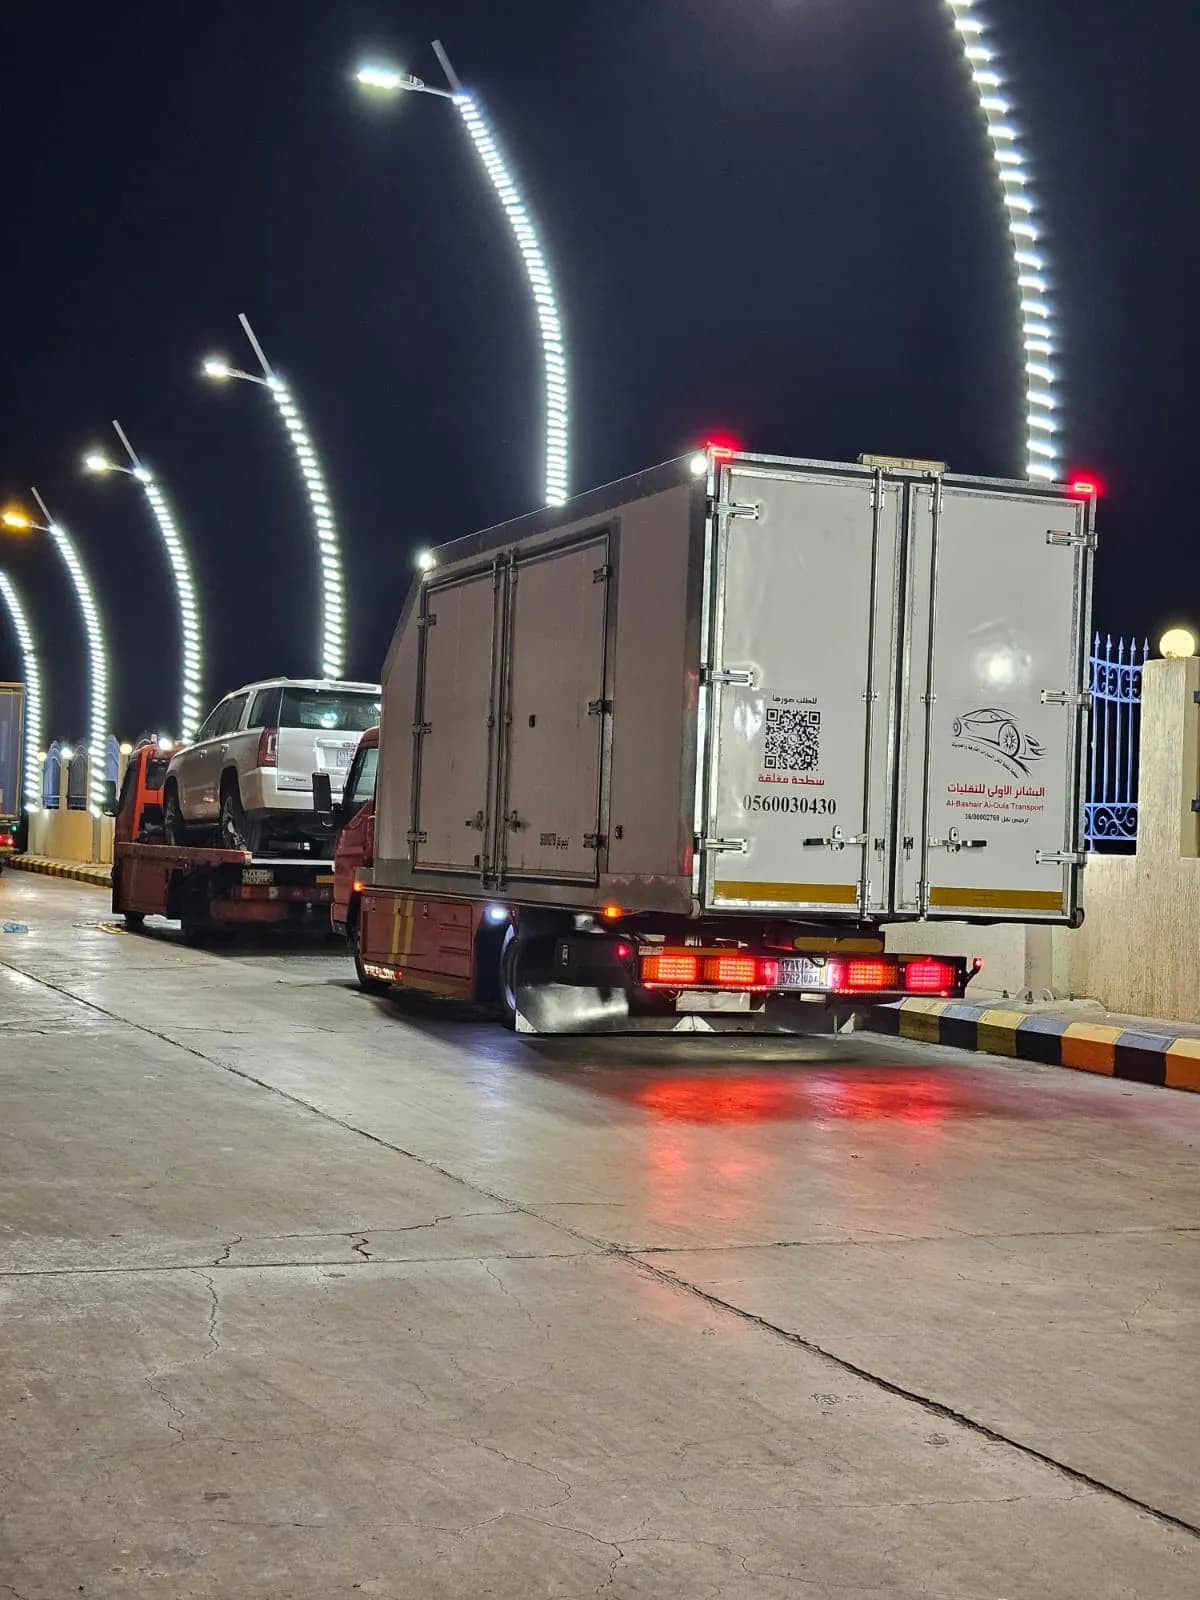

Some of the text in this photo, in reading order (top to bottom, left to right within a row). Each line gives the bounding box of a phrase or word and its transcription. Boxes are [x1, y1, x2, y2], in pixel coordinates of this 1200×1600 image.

[758, 773, 825, 786] سطحة مغلقة
[947, 783, 986, 795] للنقليات
[743, 794, 837, 815] 0560030430
[946, 800, 1045, 812] Al-Bashair Al-Oula Transport
